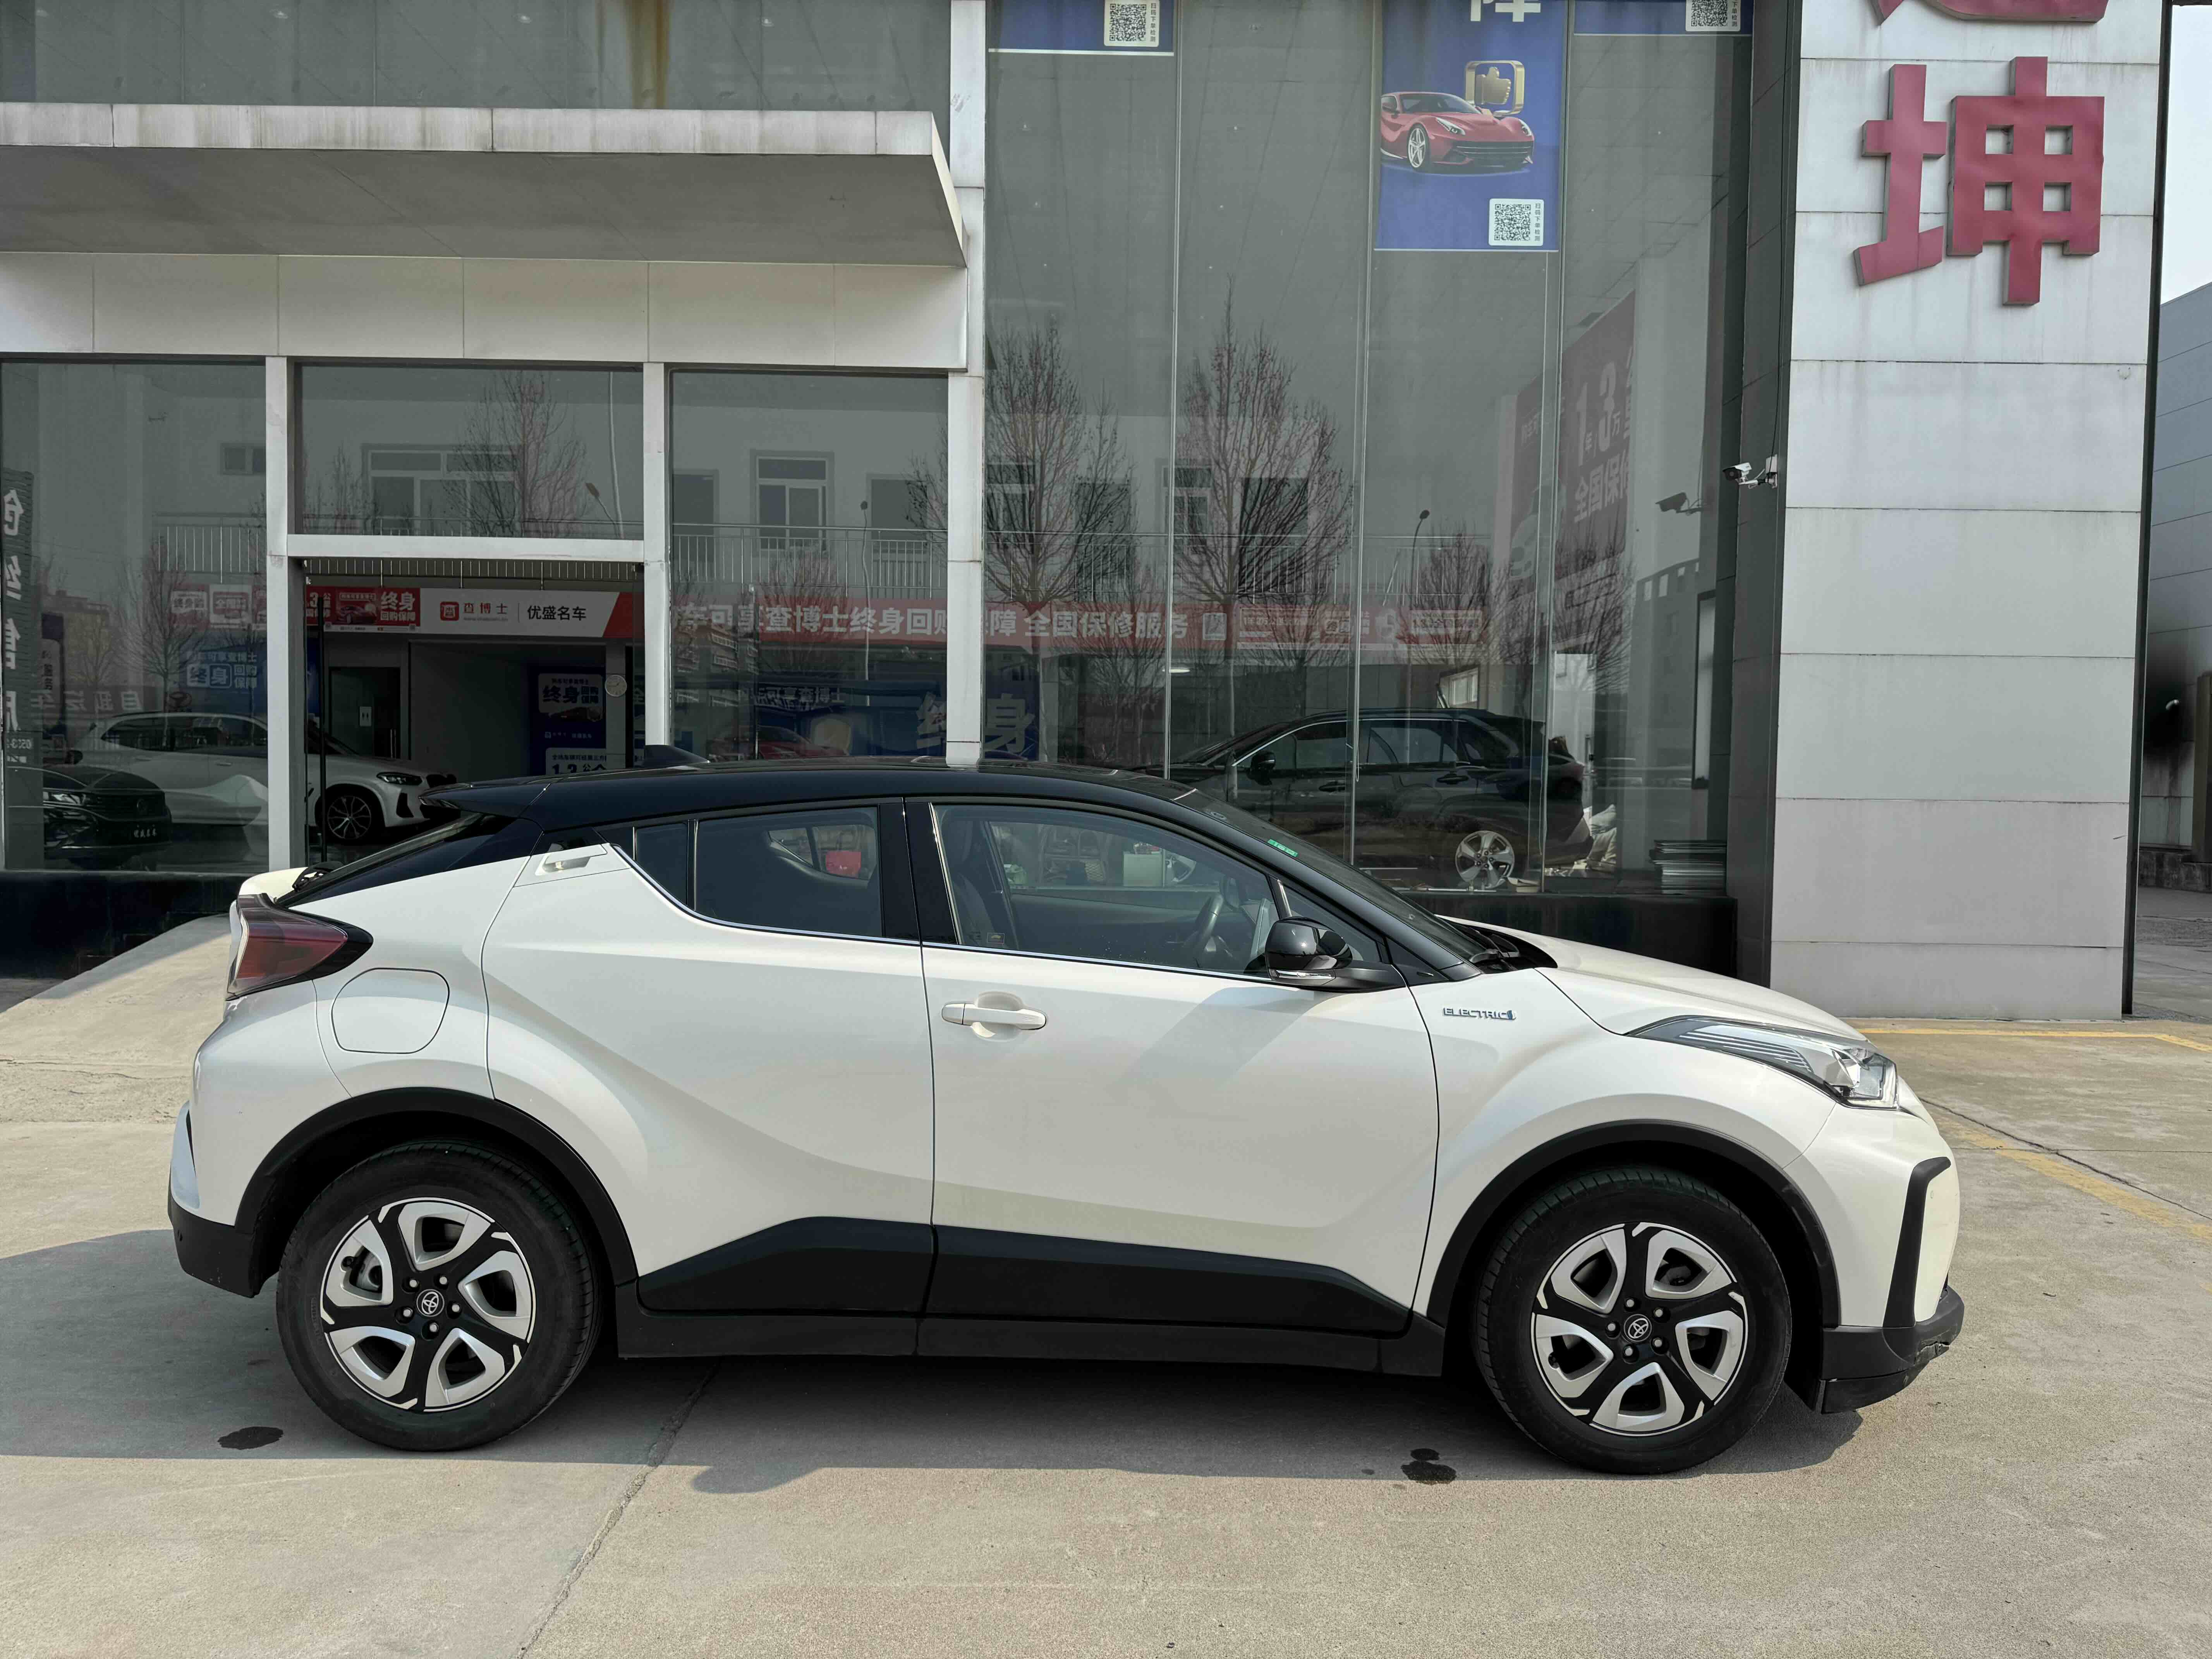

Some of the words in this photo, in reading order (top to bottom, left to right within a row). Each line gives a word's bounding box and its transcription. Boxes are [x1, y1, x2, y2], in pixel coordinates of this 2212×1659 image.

[1854, 56, 2105, 306] 坤
[381, 592, 415, 611] 终身
[380, 611, 416, 621] 回购保障
[463, 603, 508, 615] 查博士
[527, 605, 587, 621] 优盛名车
[1024, 610, 1189, 639] 全国保修服务
[543, 685, 580, 703] 终身
[1443, 1006, 1513, 1020] ELECTRIC
